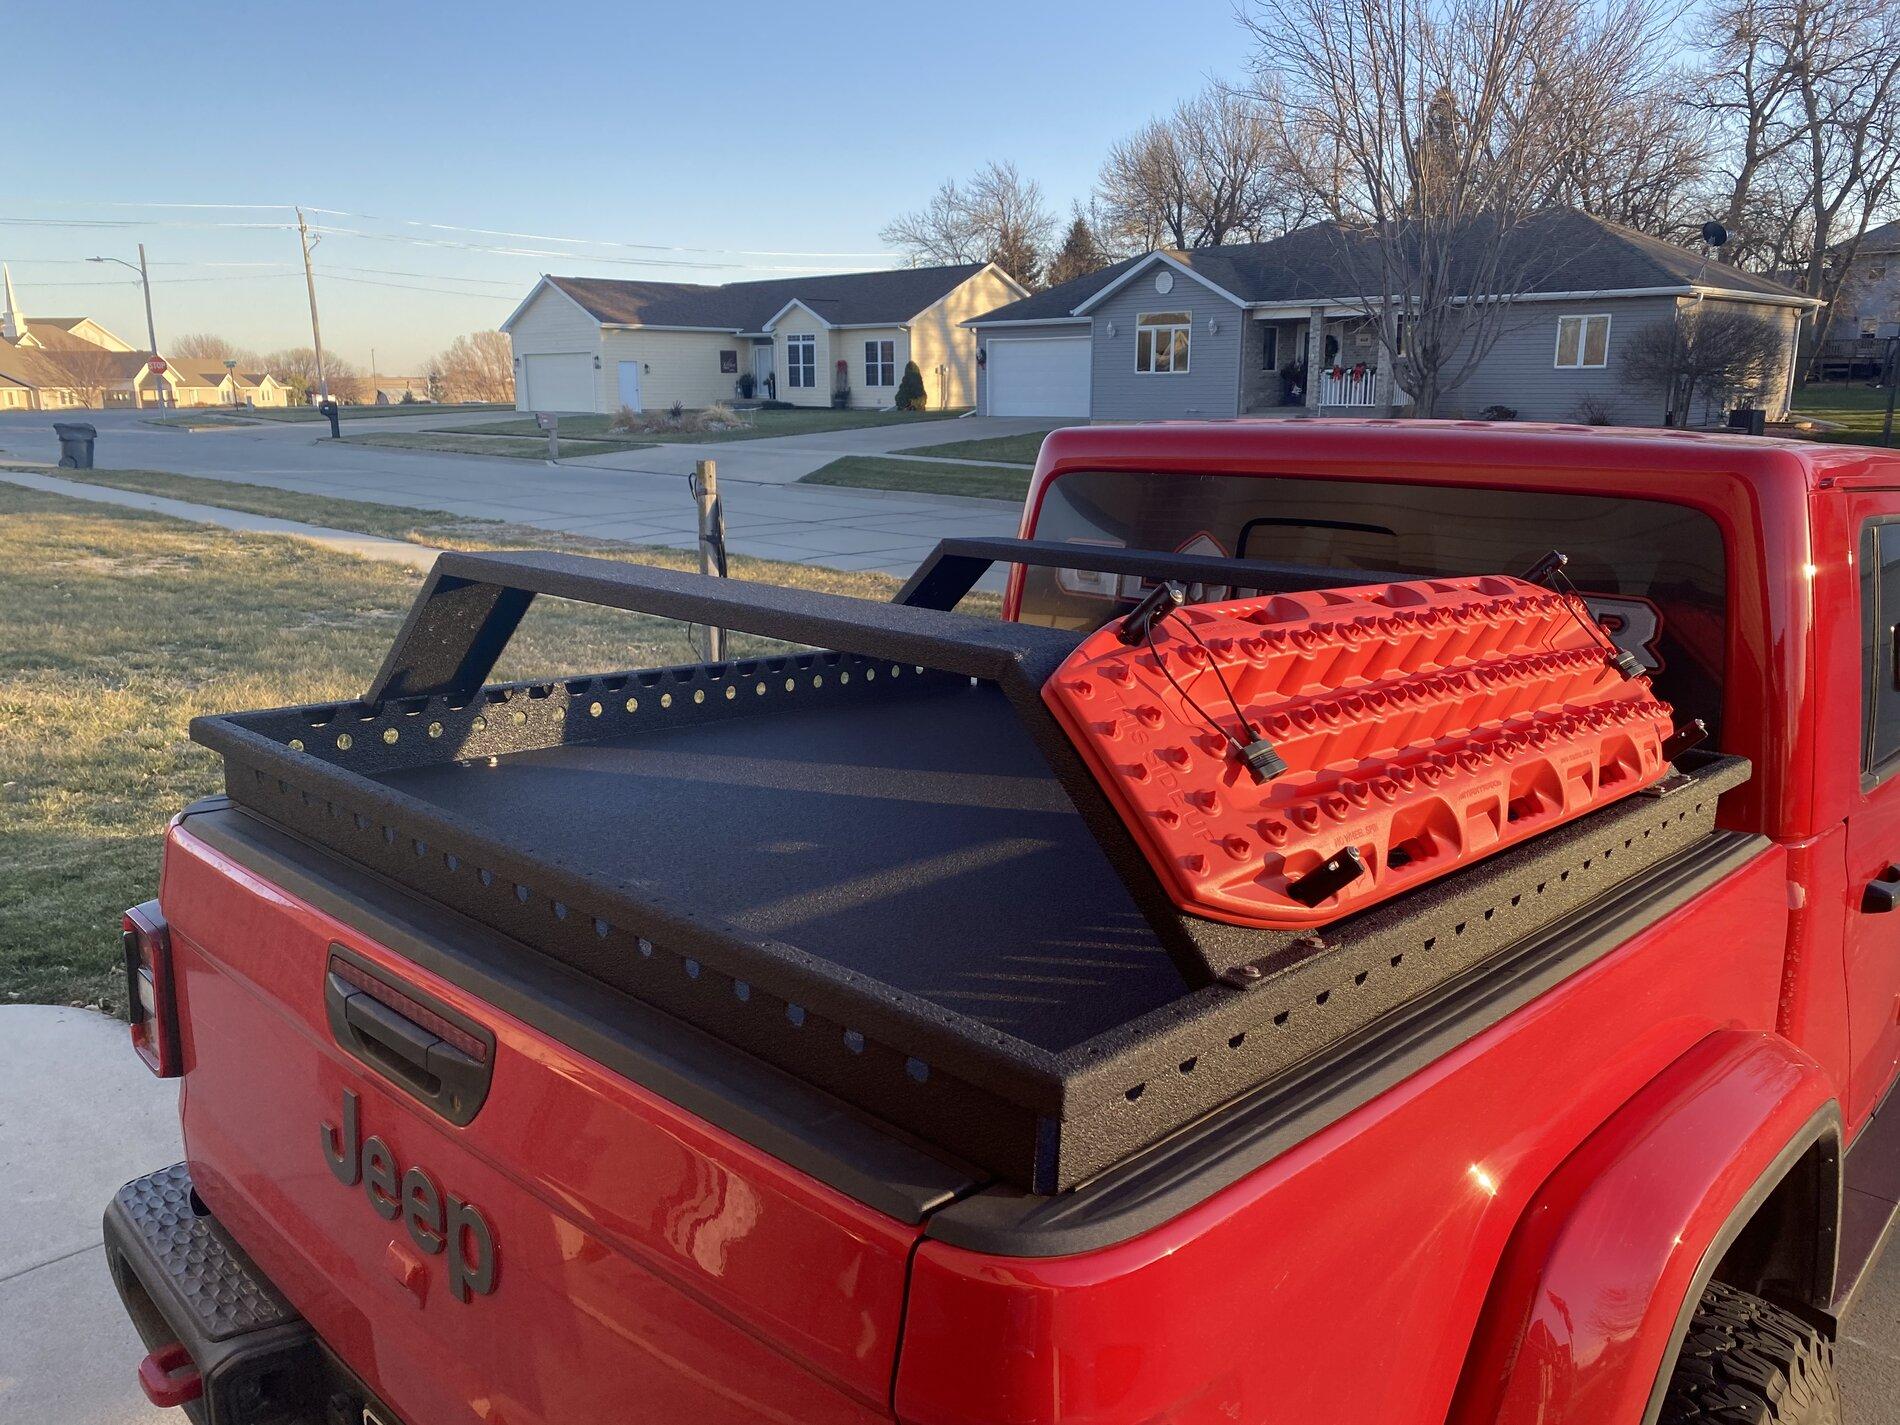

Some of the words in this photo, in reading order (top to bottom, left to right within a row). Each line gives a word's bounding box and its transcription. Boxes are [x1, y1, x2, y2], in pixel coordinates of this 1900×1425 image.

[149, 361, 166, 370] STOP
[1143, 750, 1185, 808] SIDE
[320, 1088, 500, 1305] Jeep
